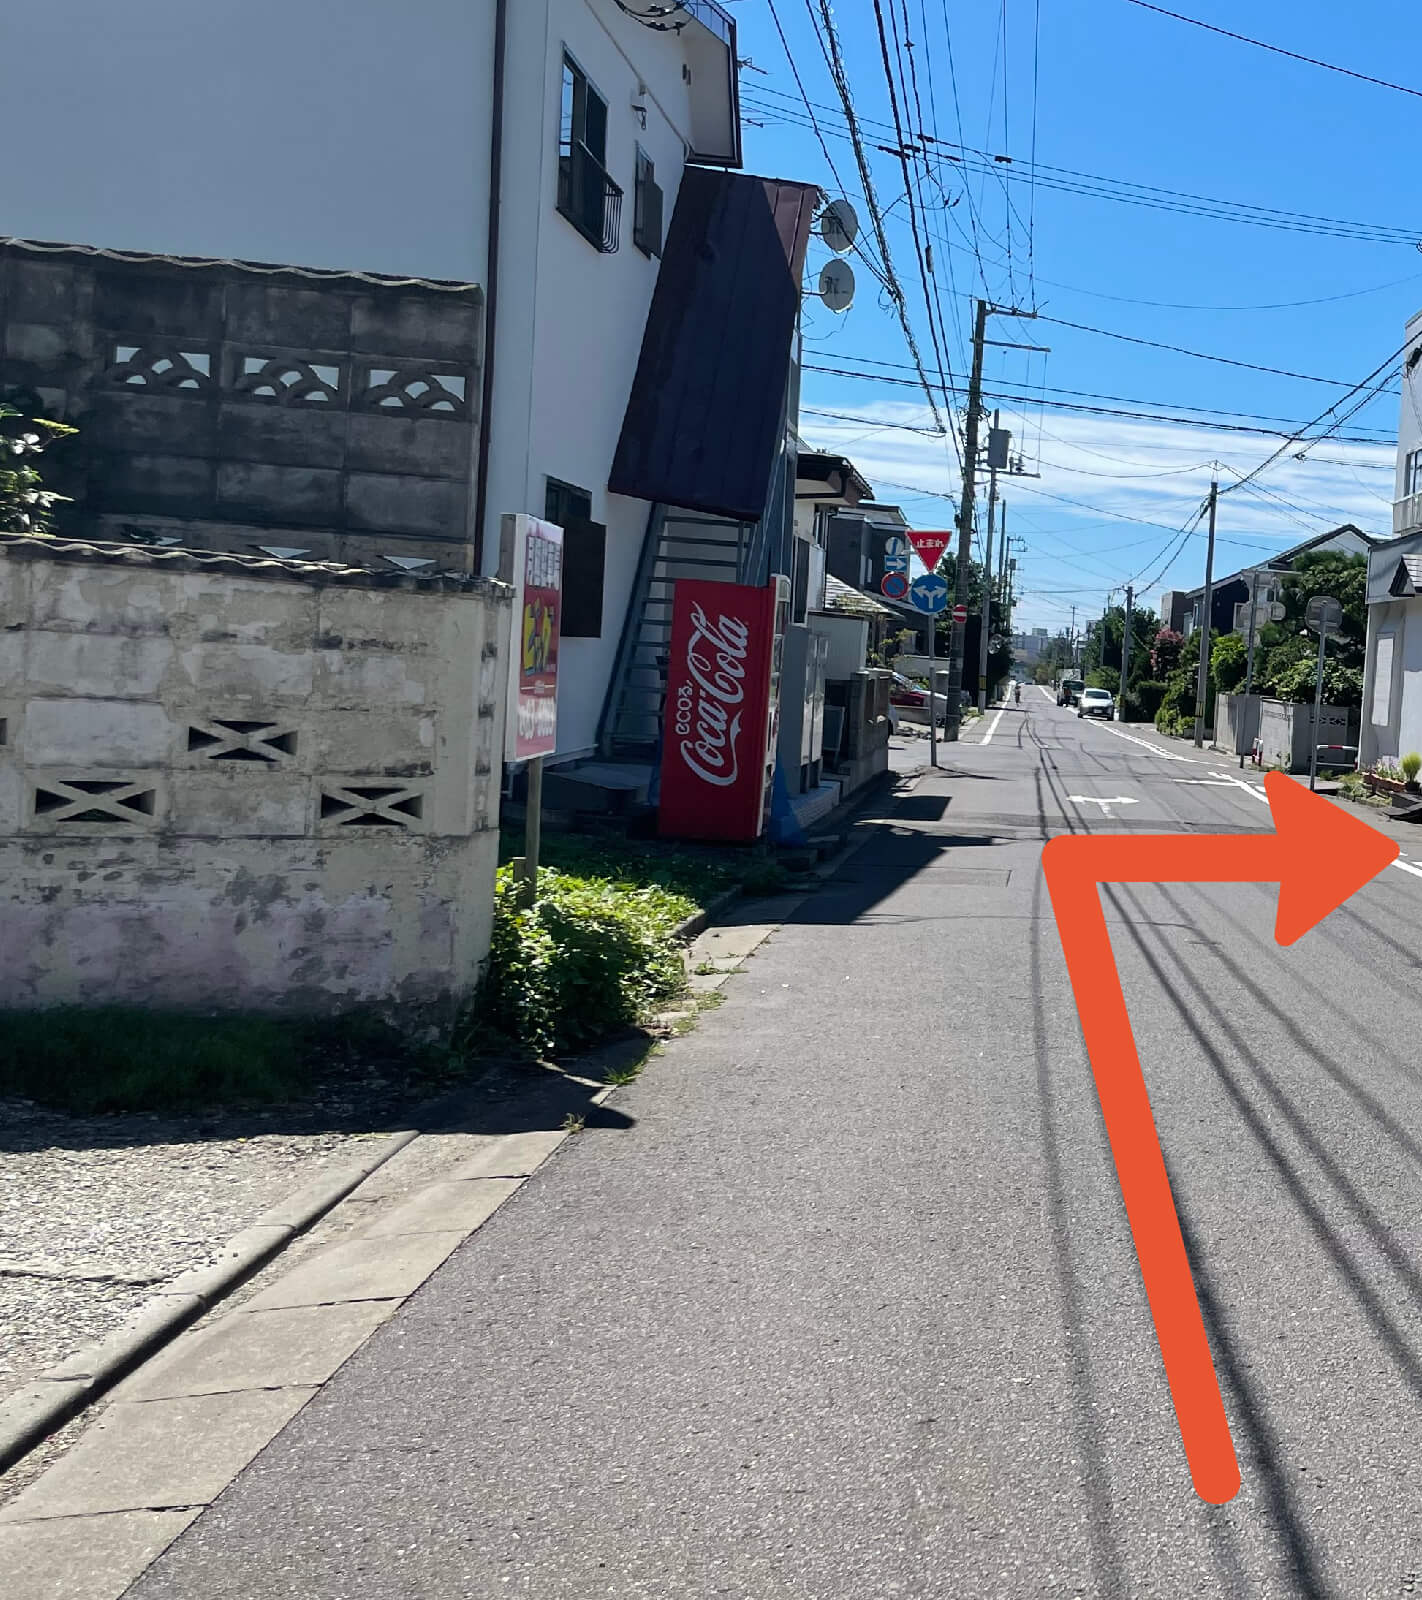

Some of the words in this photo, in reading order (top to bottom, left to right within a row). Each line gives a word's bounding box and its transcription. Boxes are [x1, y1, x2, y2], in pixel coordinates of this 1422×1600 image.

[916, 538, 945, 548] 止まれ
[680, 600, 749, 787] Coca-Cola
